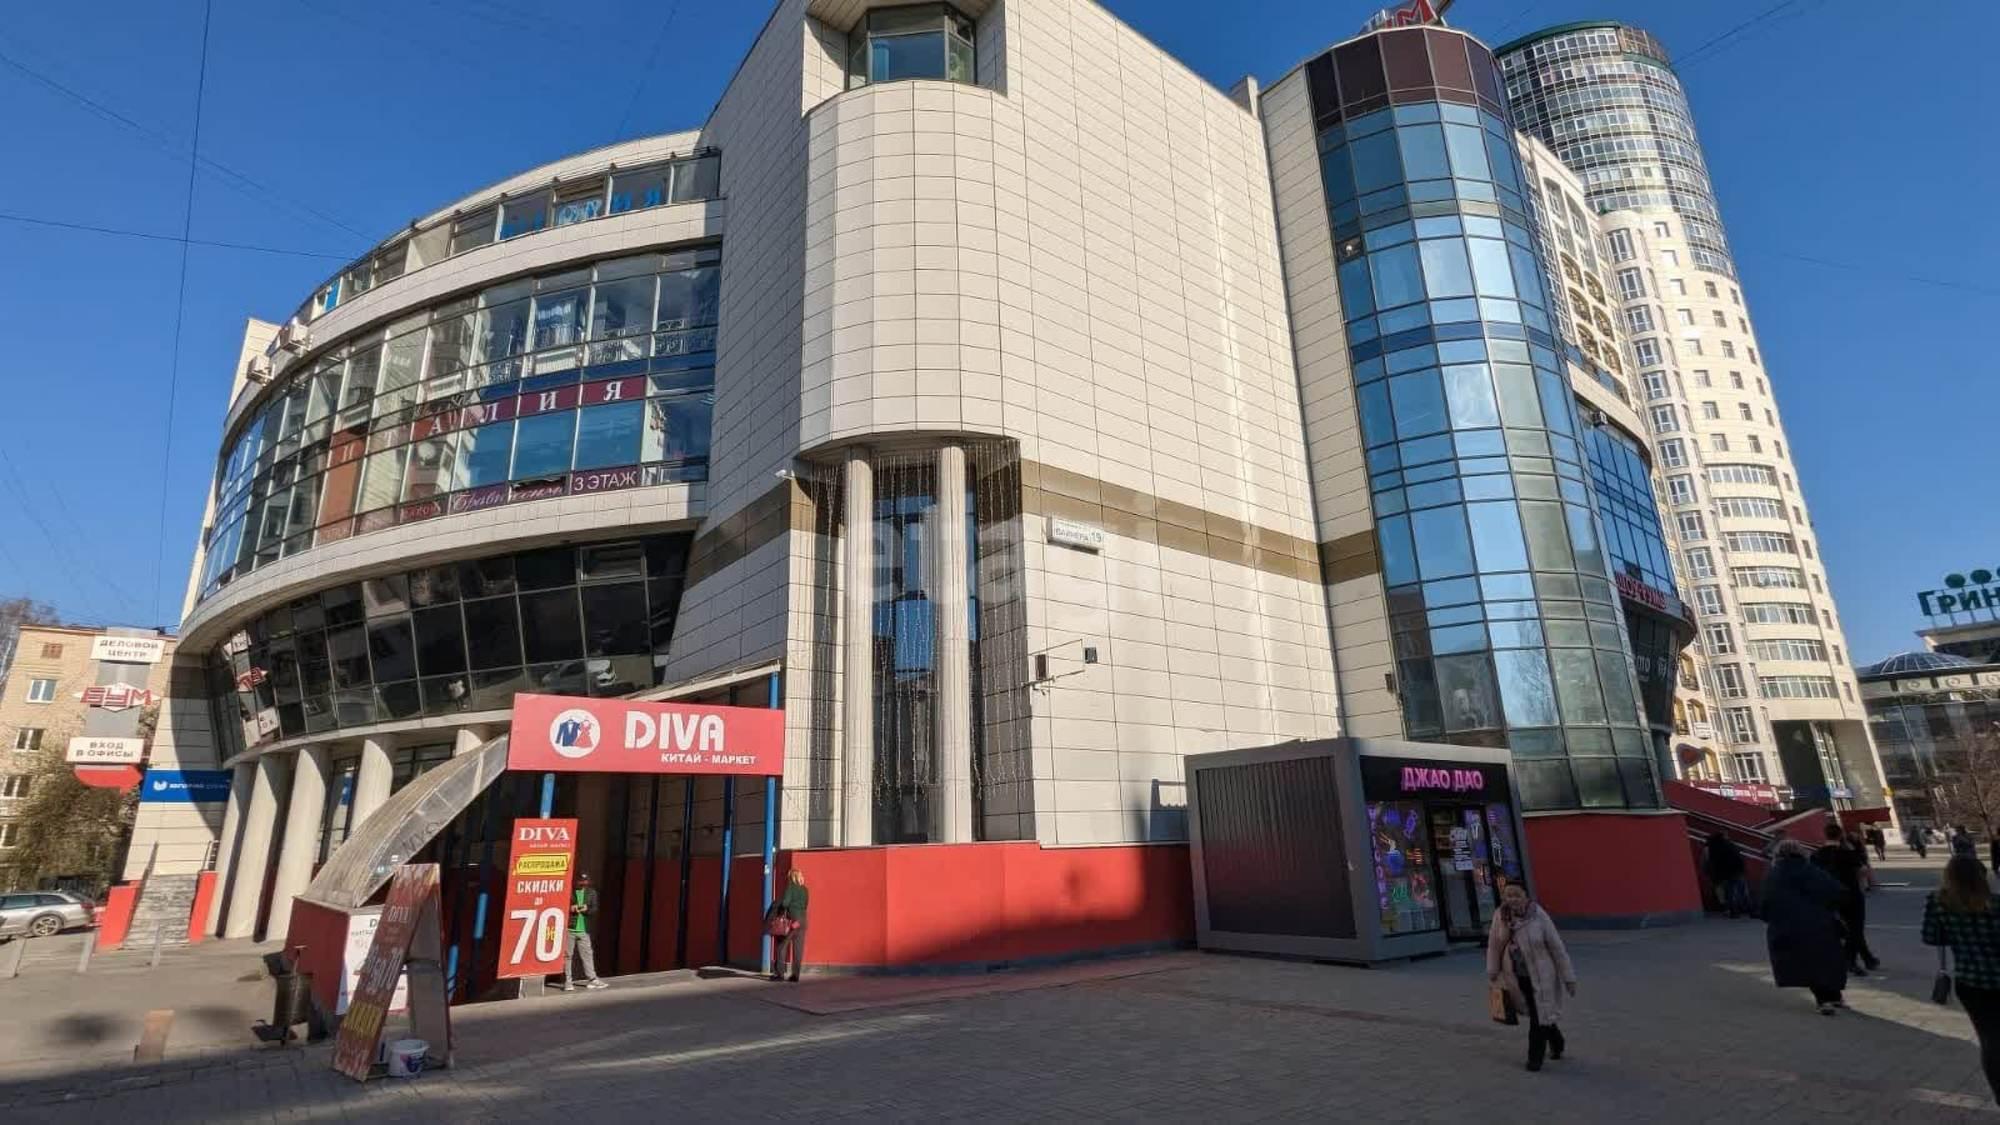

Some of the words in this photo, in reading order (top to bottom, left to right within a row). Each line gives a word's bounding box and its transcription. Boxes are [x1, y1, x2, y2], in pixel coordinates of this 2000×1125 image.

[574, 477, 584, 492] 3
[587, 470, 637, 489] ЭТАЖ
[99, 639, 158, 649] ДЕЛОВОЙ
[107, 649, 147, 657] ЦЕНТР
[80, 687, 154, 707] БУМ
[624, 710, 725, 752] DIVA
[90, 741, 124, 750] ВХОД
[76, 749, 84, 757] В
[87, 749, 134, 758] ОФИСЫ
[661, 751, 701, 764] КИТАЙ
[712, 755, 756, 765] МАРКЕТ
[1402, 767, 1450, 790] ДЖАО
[1454, 770, 1484, 791] ДАО
[519, 826, 570, 841] DIVA
[518, 859, 566, 871] РАСПРОДАЖА
[516, 879, 564, 894] СКИДКИ
[510, 907, 565, 965] 70
